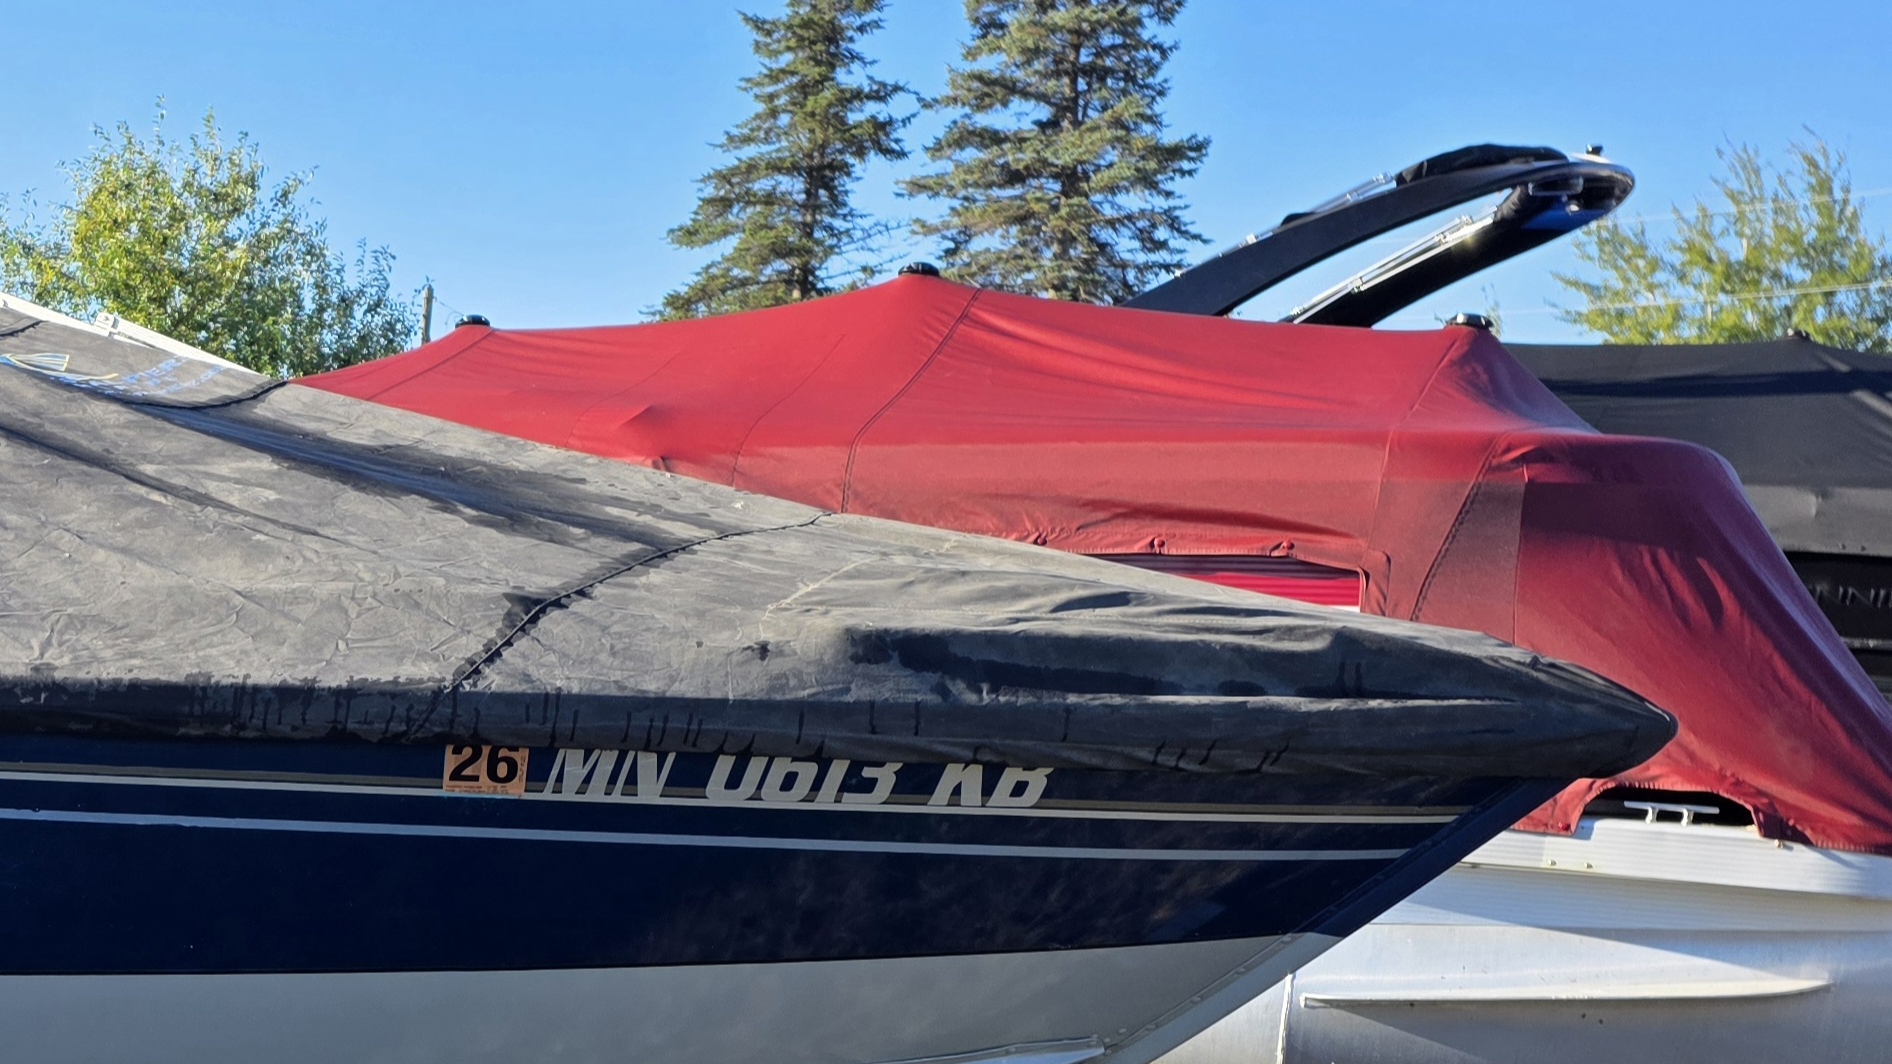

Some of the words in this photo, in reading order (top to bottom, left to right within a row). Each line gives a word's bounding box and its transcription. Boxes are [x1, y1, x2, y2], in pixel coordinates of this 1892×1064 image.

[448, 744, 519, 785] 26
[542, 748, 677, 797] MN
[704, 753, 905, 805] 0613
[926, 762, 1055, 808] KB
